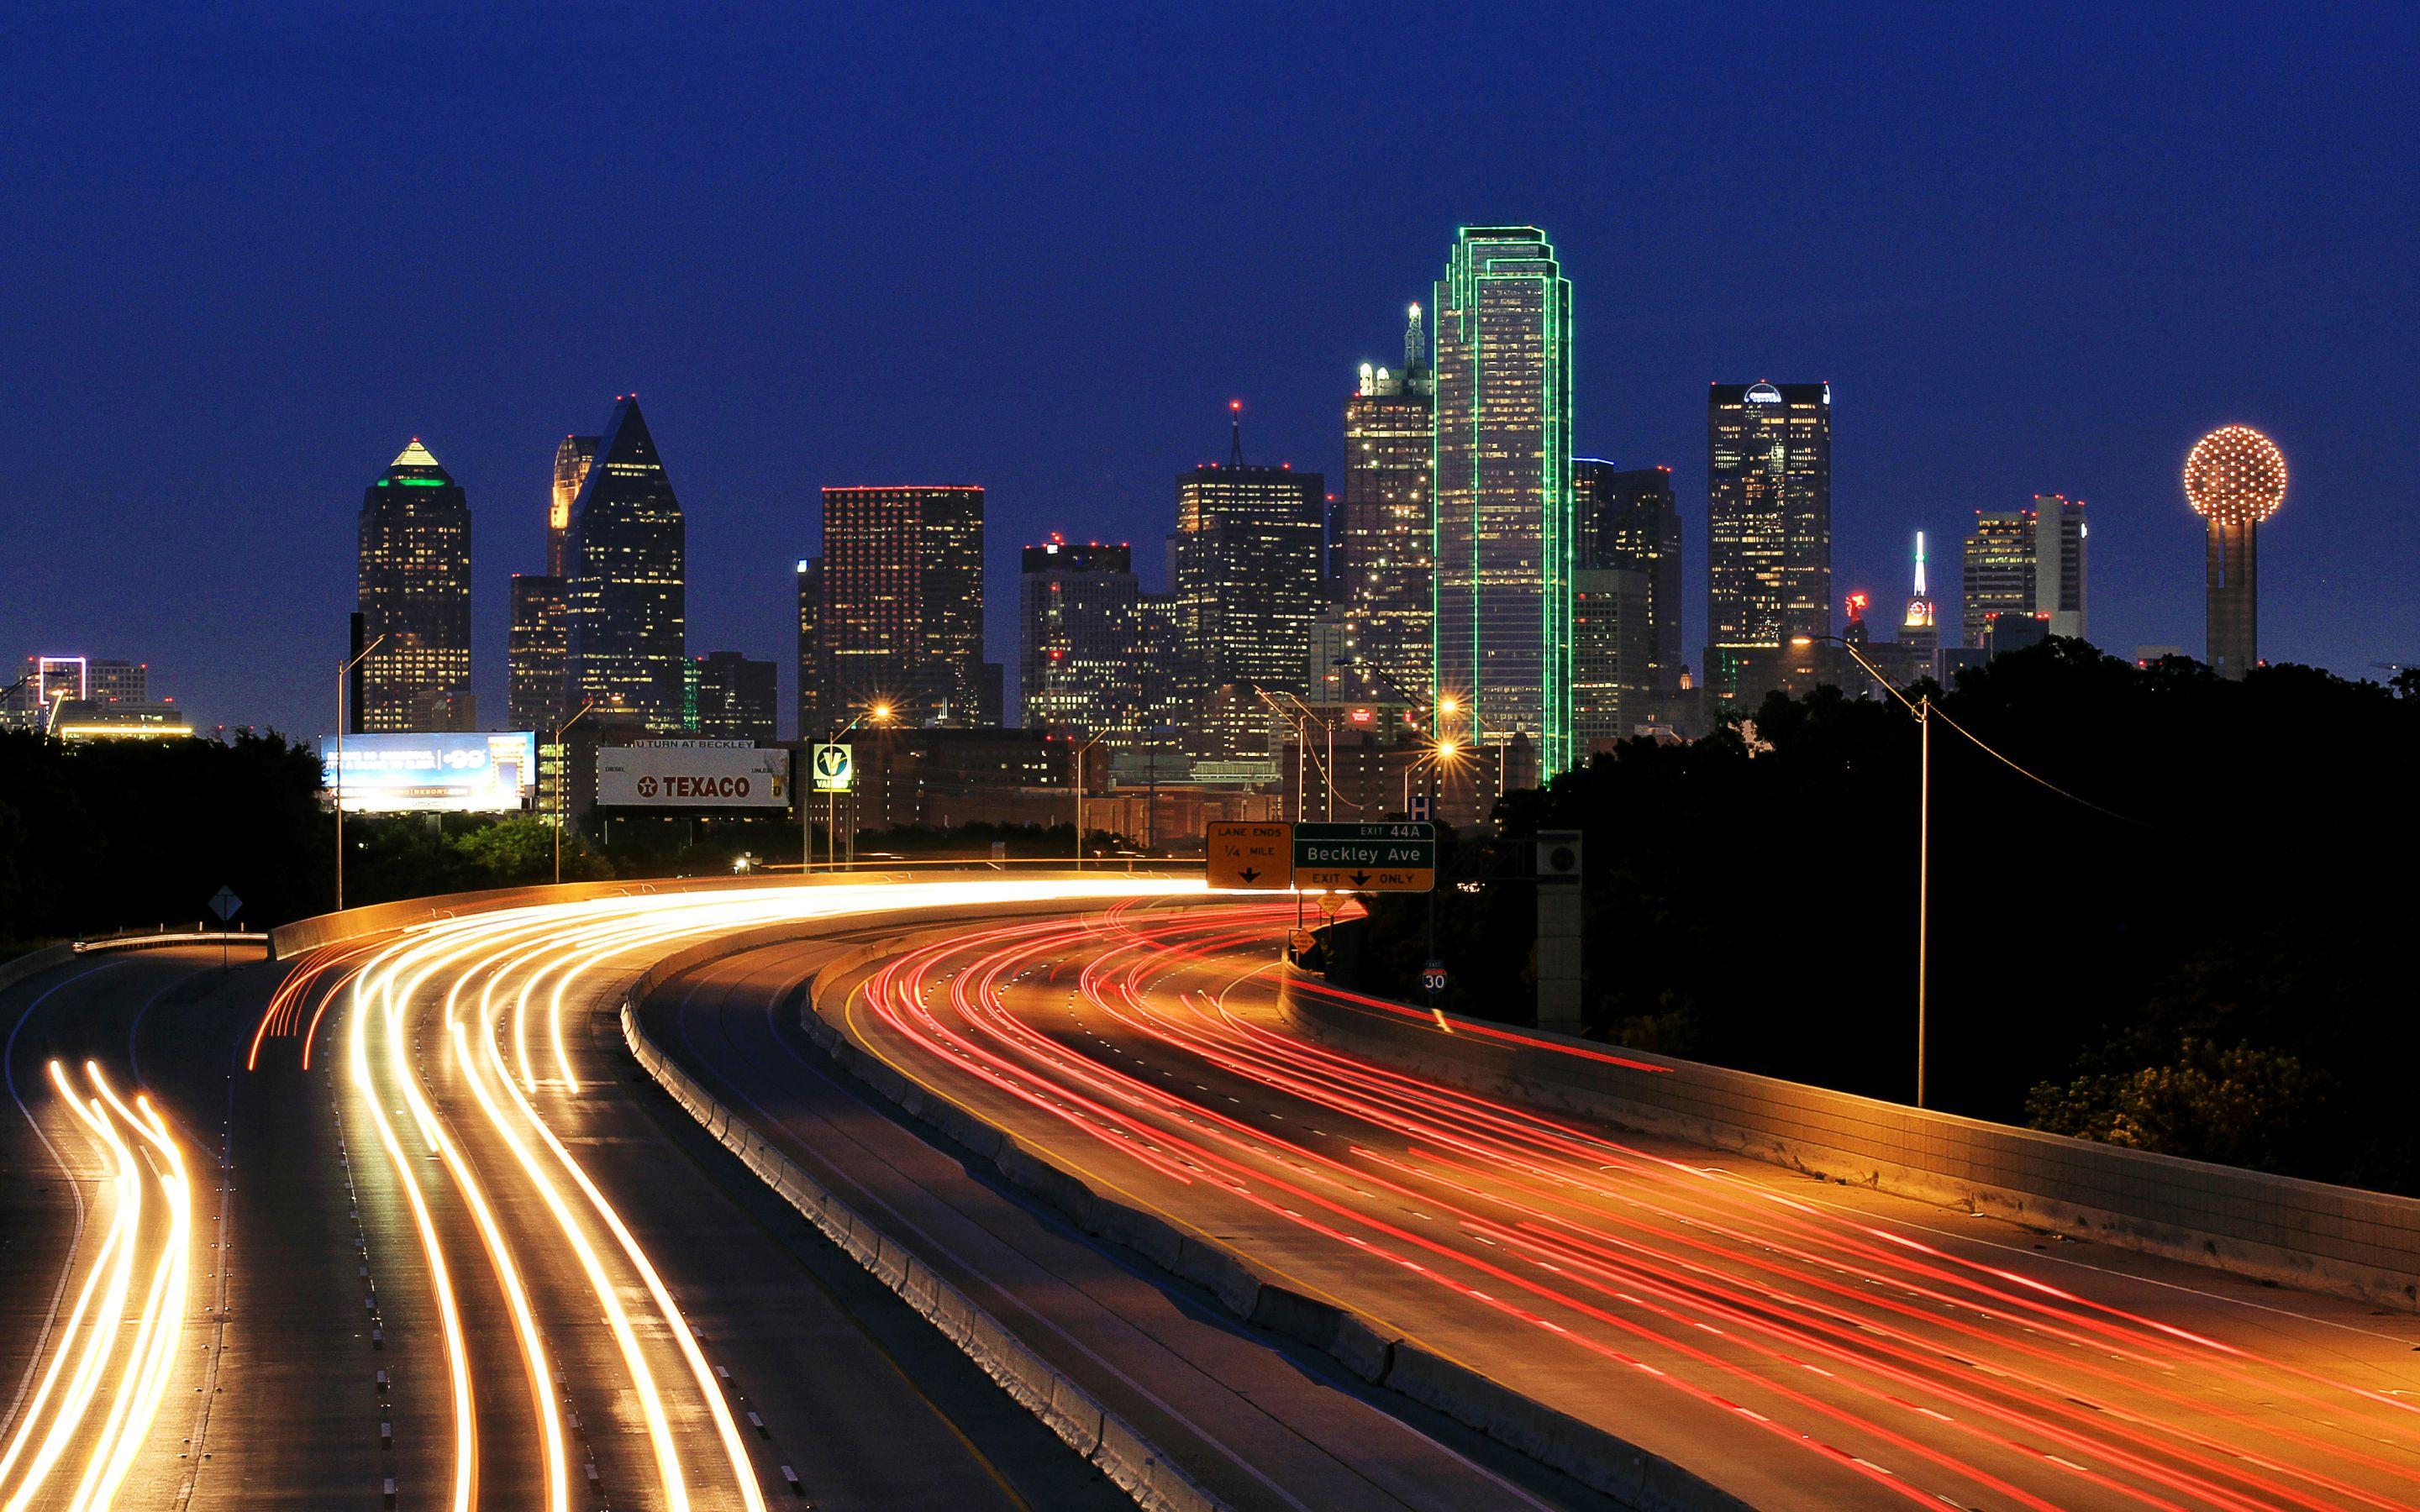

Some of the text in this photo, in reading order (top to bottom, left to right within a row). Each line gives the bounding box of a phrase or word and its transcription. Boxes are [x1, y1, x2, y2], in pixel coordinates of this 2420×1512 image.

[663, 776, 750, 797] TEXACO
[1412, 797, 1429, 821] H
[1218, 827, 1282, 837] LANE ENDS
[1360, 825, 1420, 837] EXIT 44A
[1250, 847, 1275, 856] MILE
[1307, 847, 1420, 864] Beckley Ave
[1312, 874, 1415, 884] EXIT ONLY
[1425, 974, 1444, 989] 30
